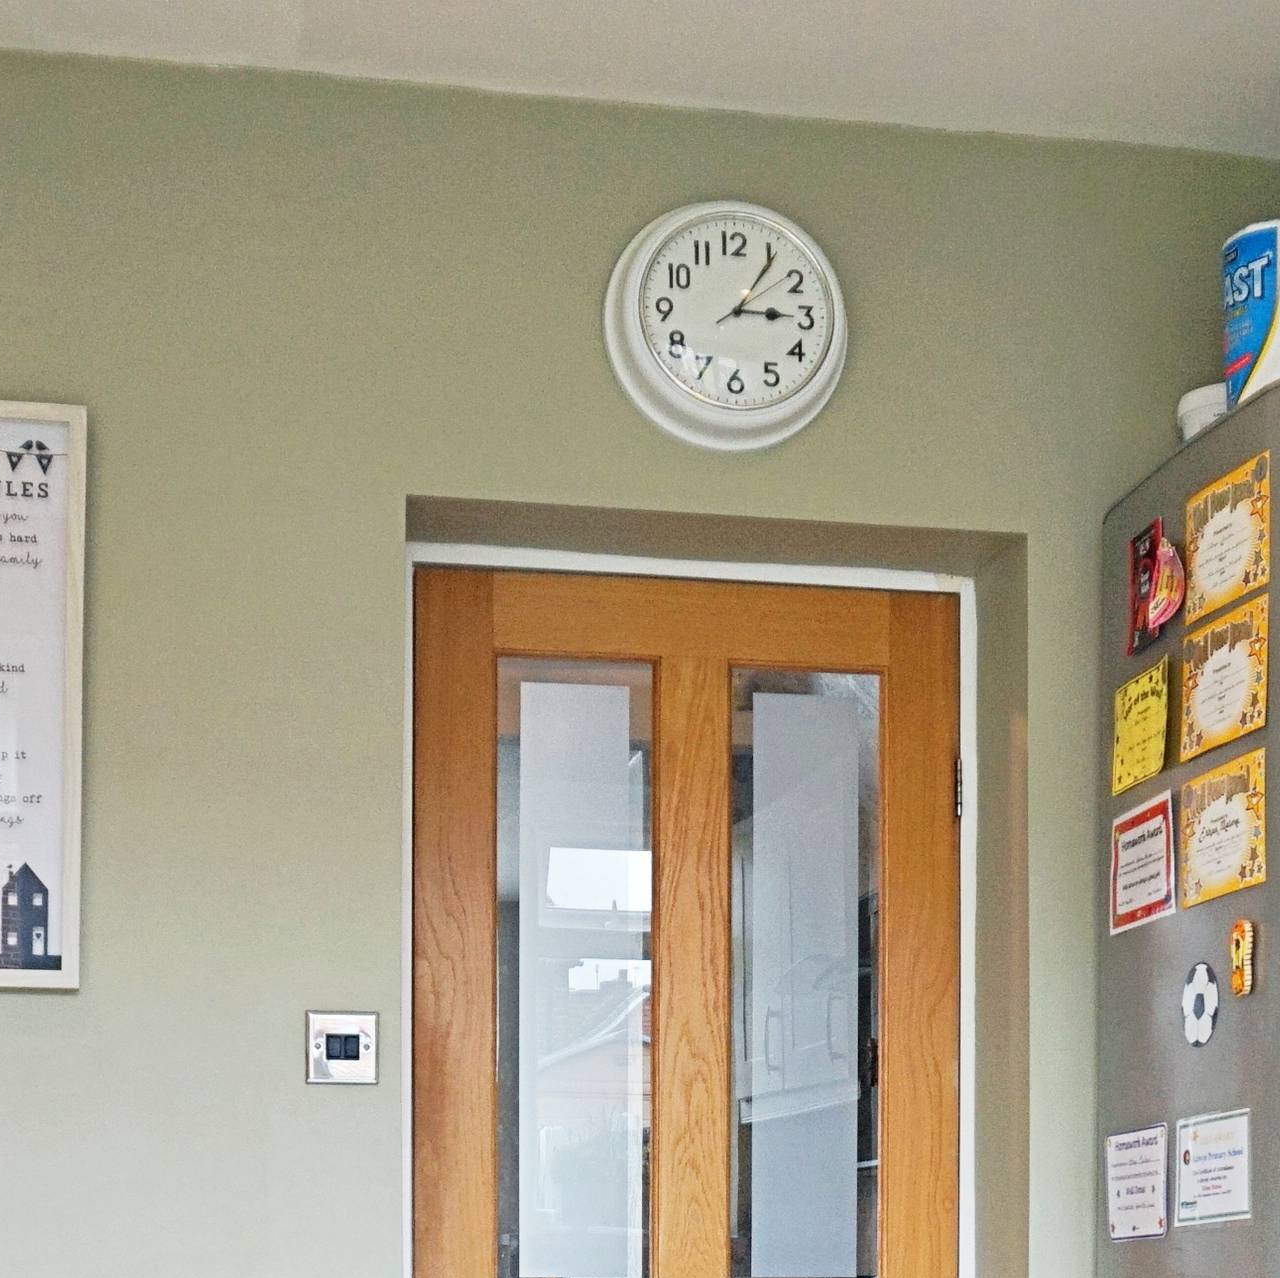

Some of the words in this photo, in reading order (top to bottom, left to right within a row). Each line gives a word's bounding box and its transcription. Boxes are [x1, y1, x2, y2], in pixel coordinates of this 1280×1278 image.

[693, 240, 711, 266] 11
[720, 230, 748, 257] 12
[667, 263, 691, 290] 10
[786, 269, 804, 294] 2
[655, 297, 674, 322] 9
[797, 304, 815, 331] 3
[668, 330, 687, 359] 8
[785, 339, 806, 363] 4
[695, 355, 713, 380] 7
[763, 362, 780, 388] 5
[726, 369, 745, 395] 6
[2, 511, 28, 524] you
[9, 533, 38, 543] hard
[14, 750, 27, 760] it
[22, 793, 43, 804] off
